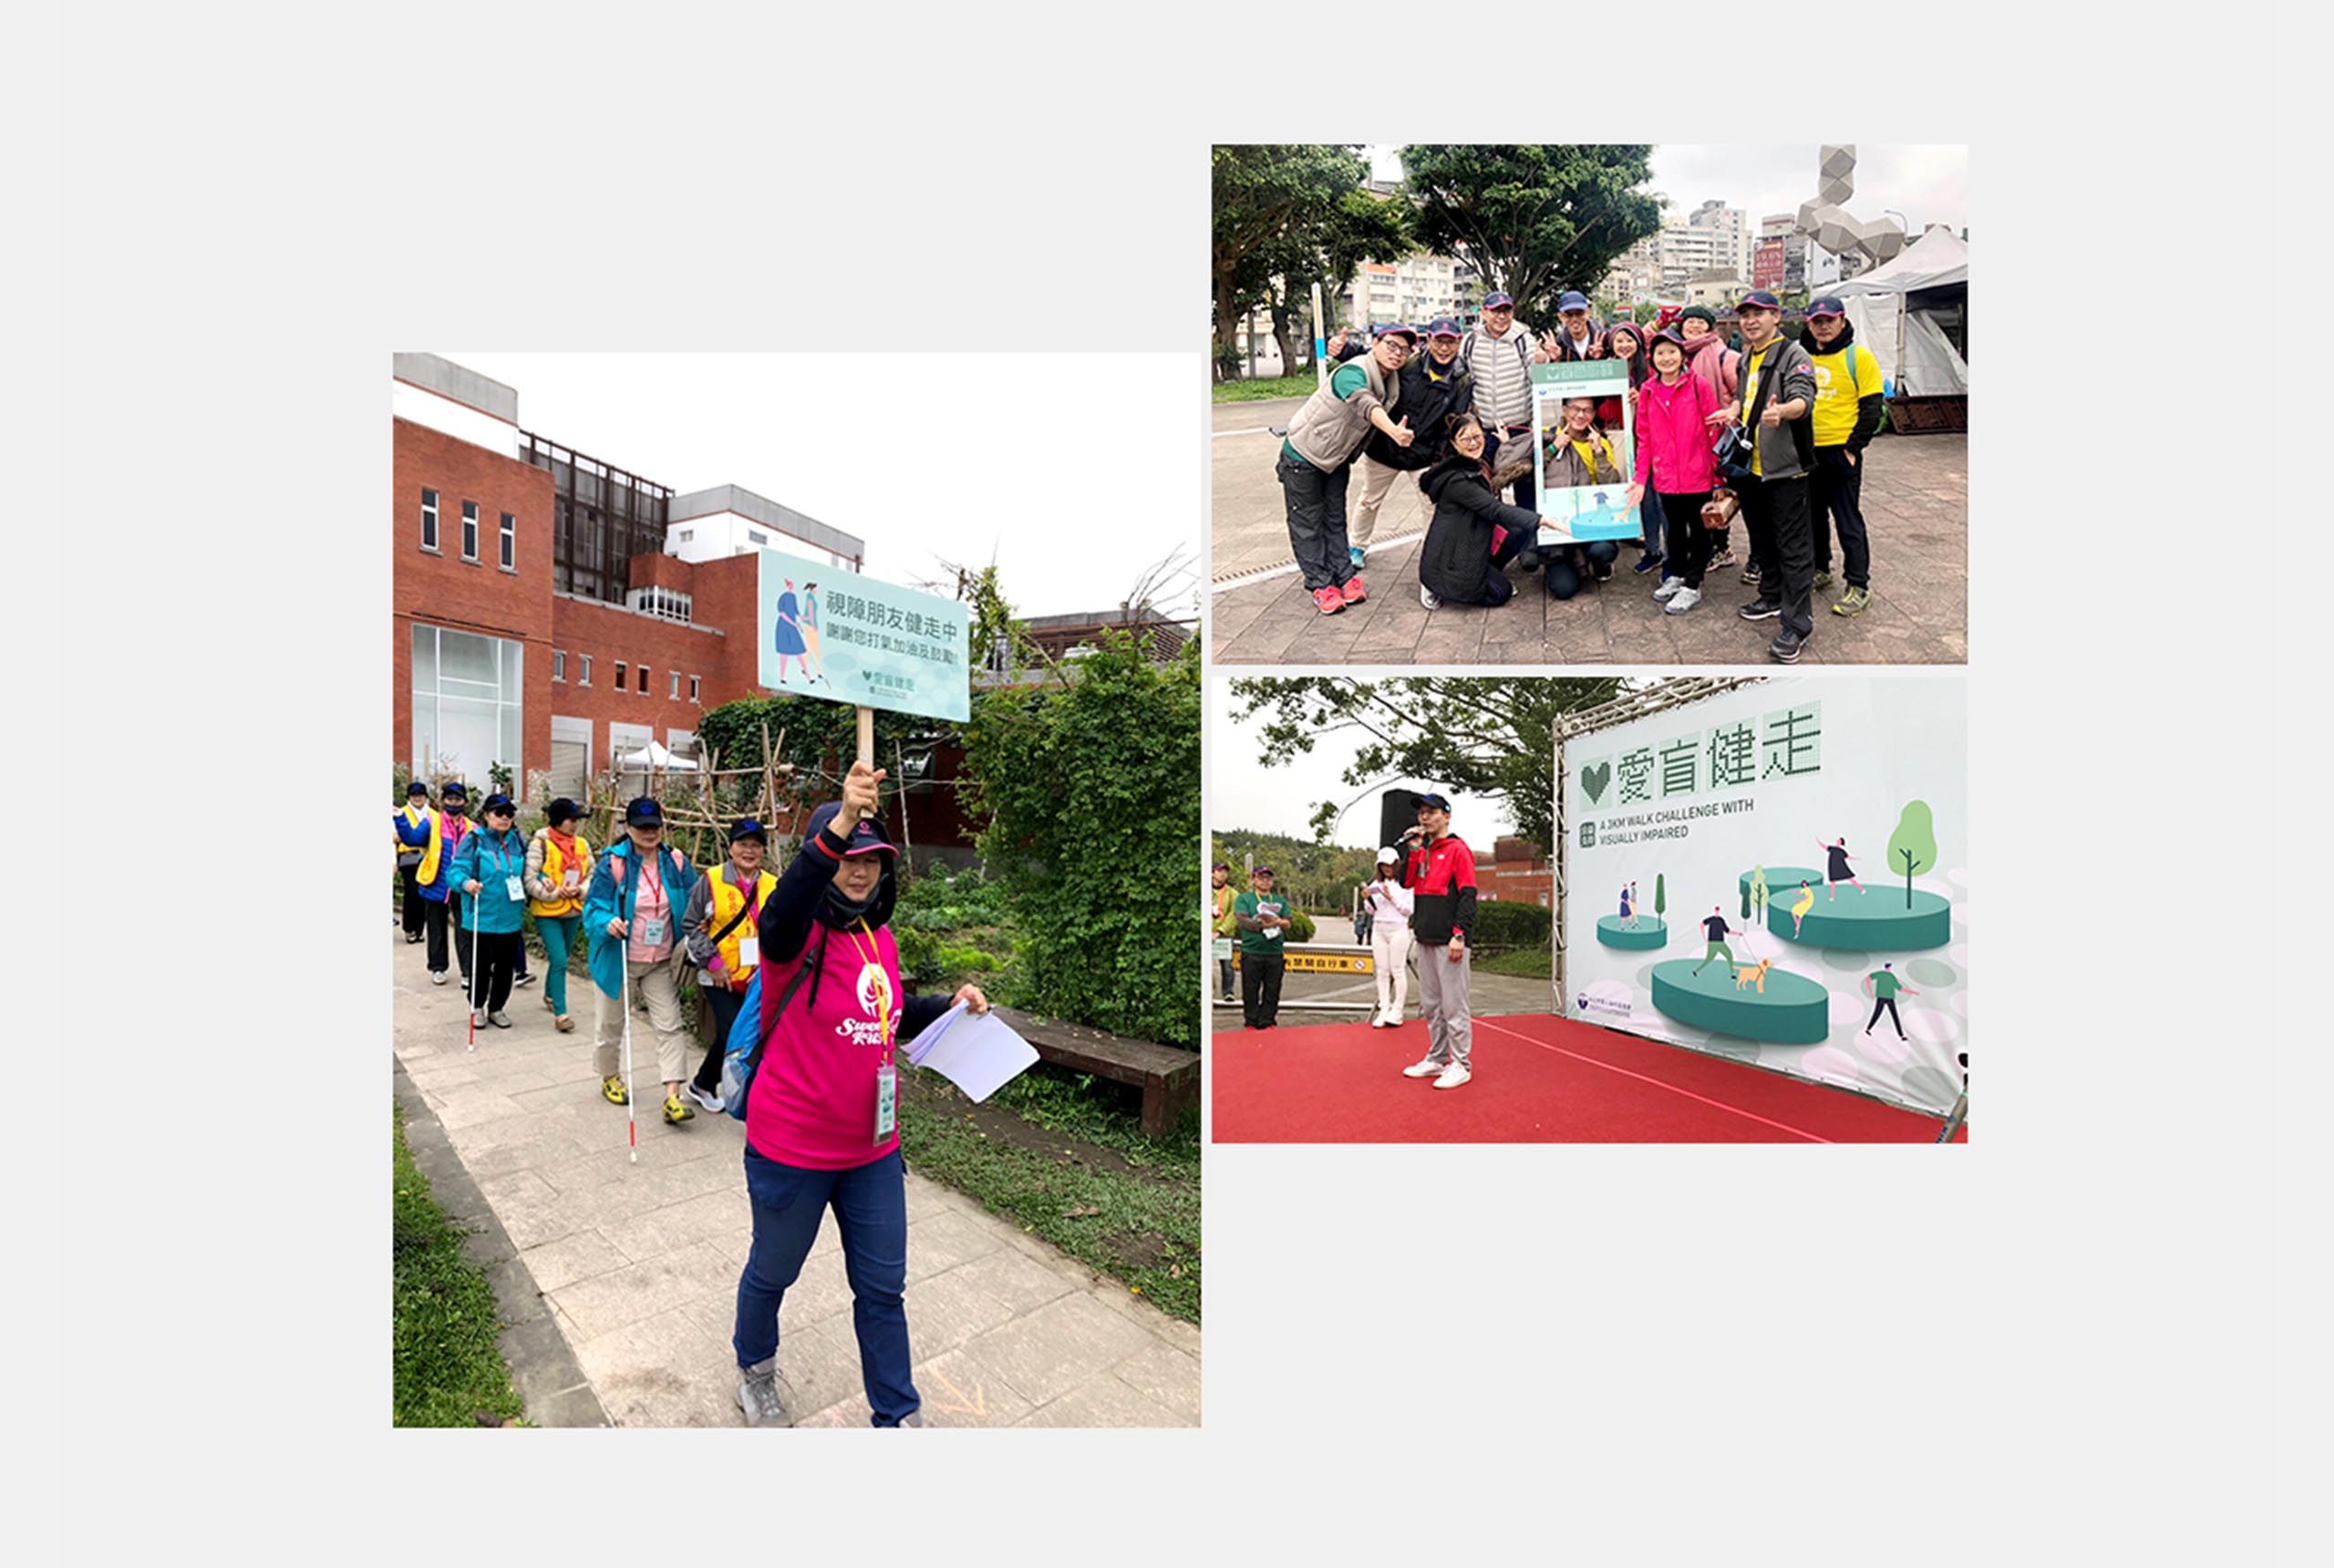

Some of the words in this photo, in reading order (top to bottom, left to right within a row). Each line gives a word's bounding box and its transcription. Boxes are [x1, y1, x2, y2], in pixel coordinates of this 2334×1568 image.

[826, 590, 957, 643] 視障朋友健走中
[1617, 710, 1822, 804] 愛盲健走
[1599, 821, 1606, 830] A
[1607, 820, 1626, 830] 3KM
[1627, 815, 1655, 827] WALK
[1655, 802, 1720, 823] CHALLENGE
[1721, 798, 1754, 814] WITH
[1600, 831, 1639, 846] VISUALLY
[1640, 825, 1689, 841] IMPAIRED
